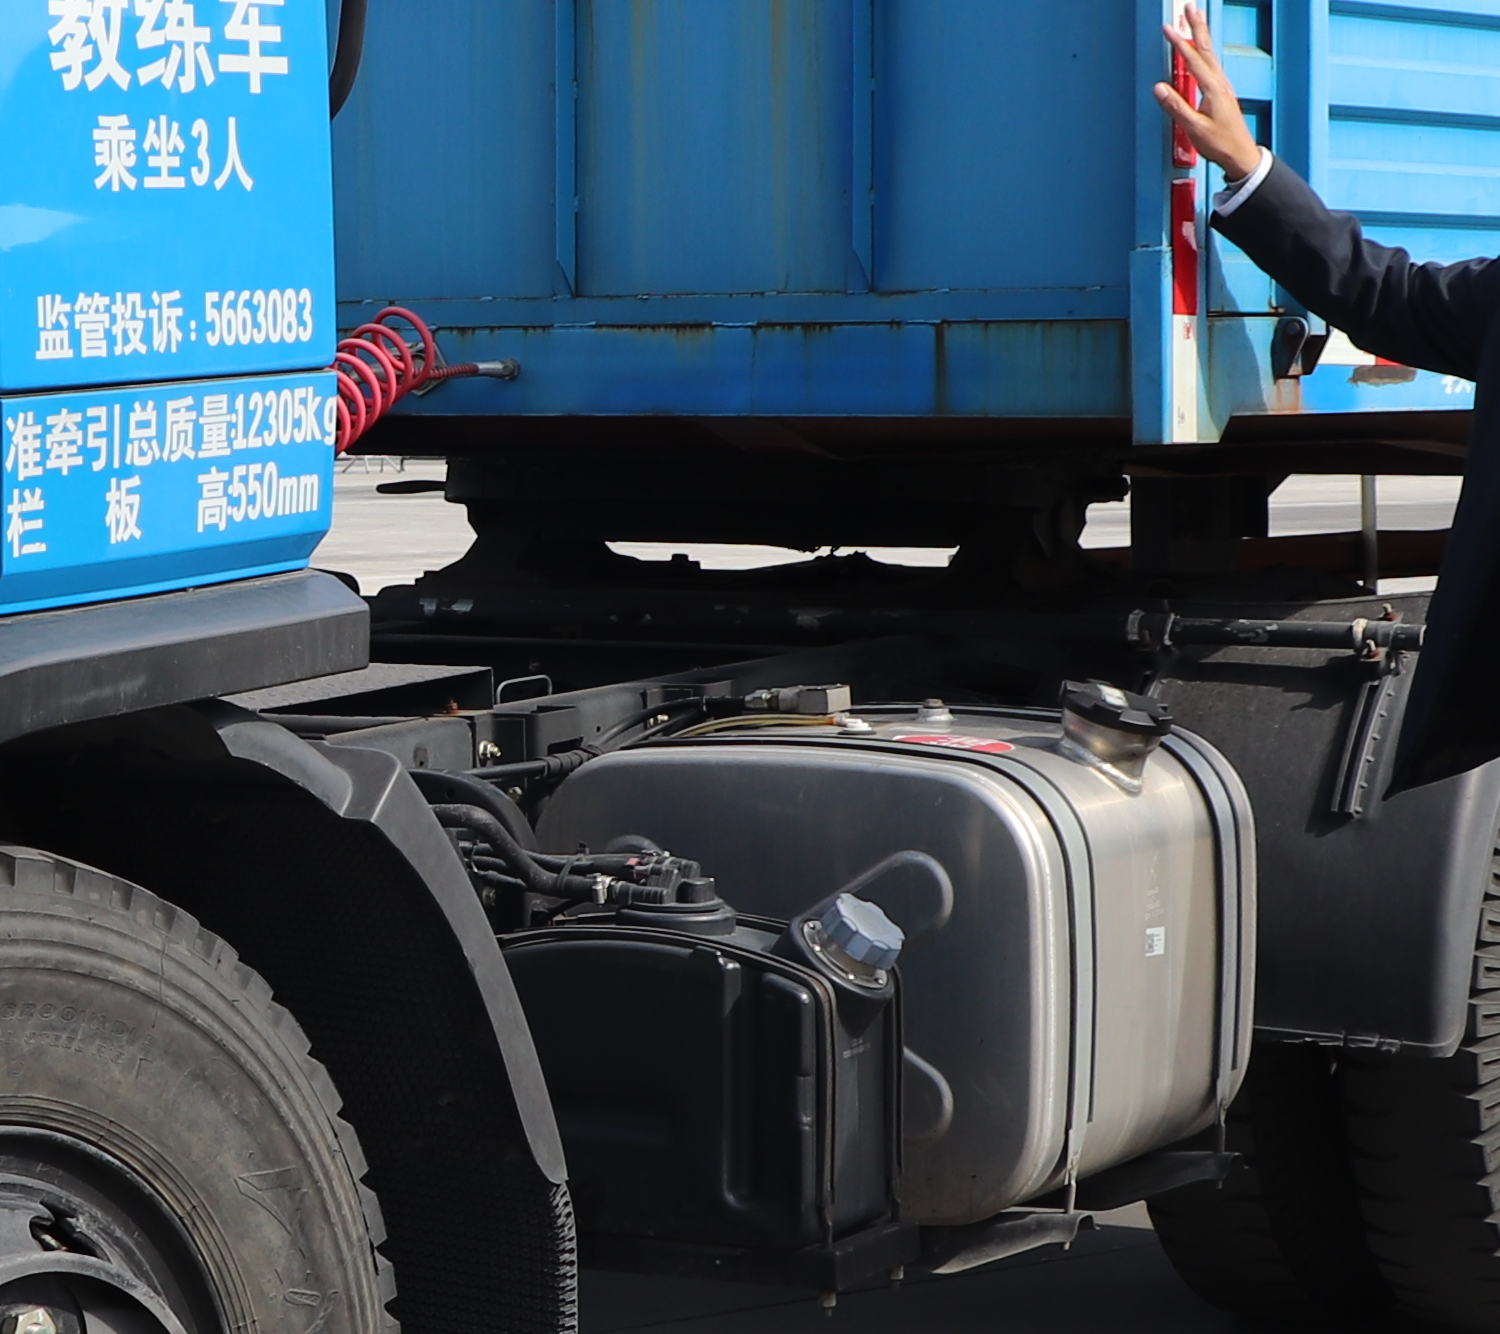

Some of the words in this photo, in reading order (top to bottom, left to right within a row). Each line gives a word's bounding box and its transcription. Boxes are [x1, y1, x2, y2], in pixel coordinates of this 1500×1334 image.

[92, 114, 254, 192] 乘坐3人
[35, 288, 314, 360] 监管投诉:5663083
[6, 487, 47, 558] 栏
[105, 474, 143, 544] 板
